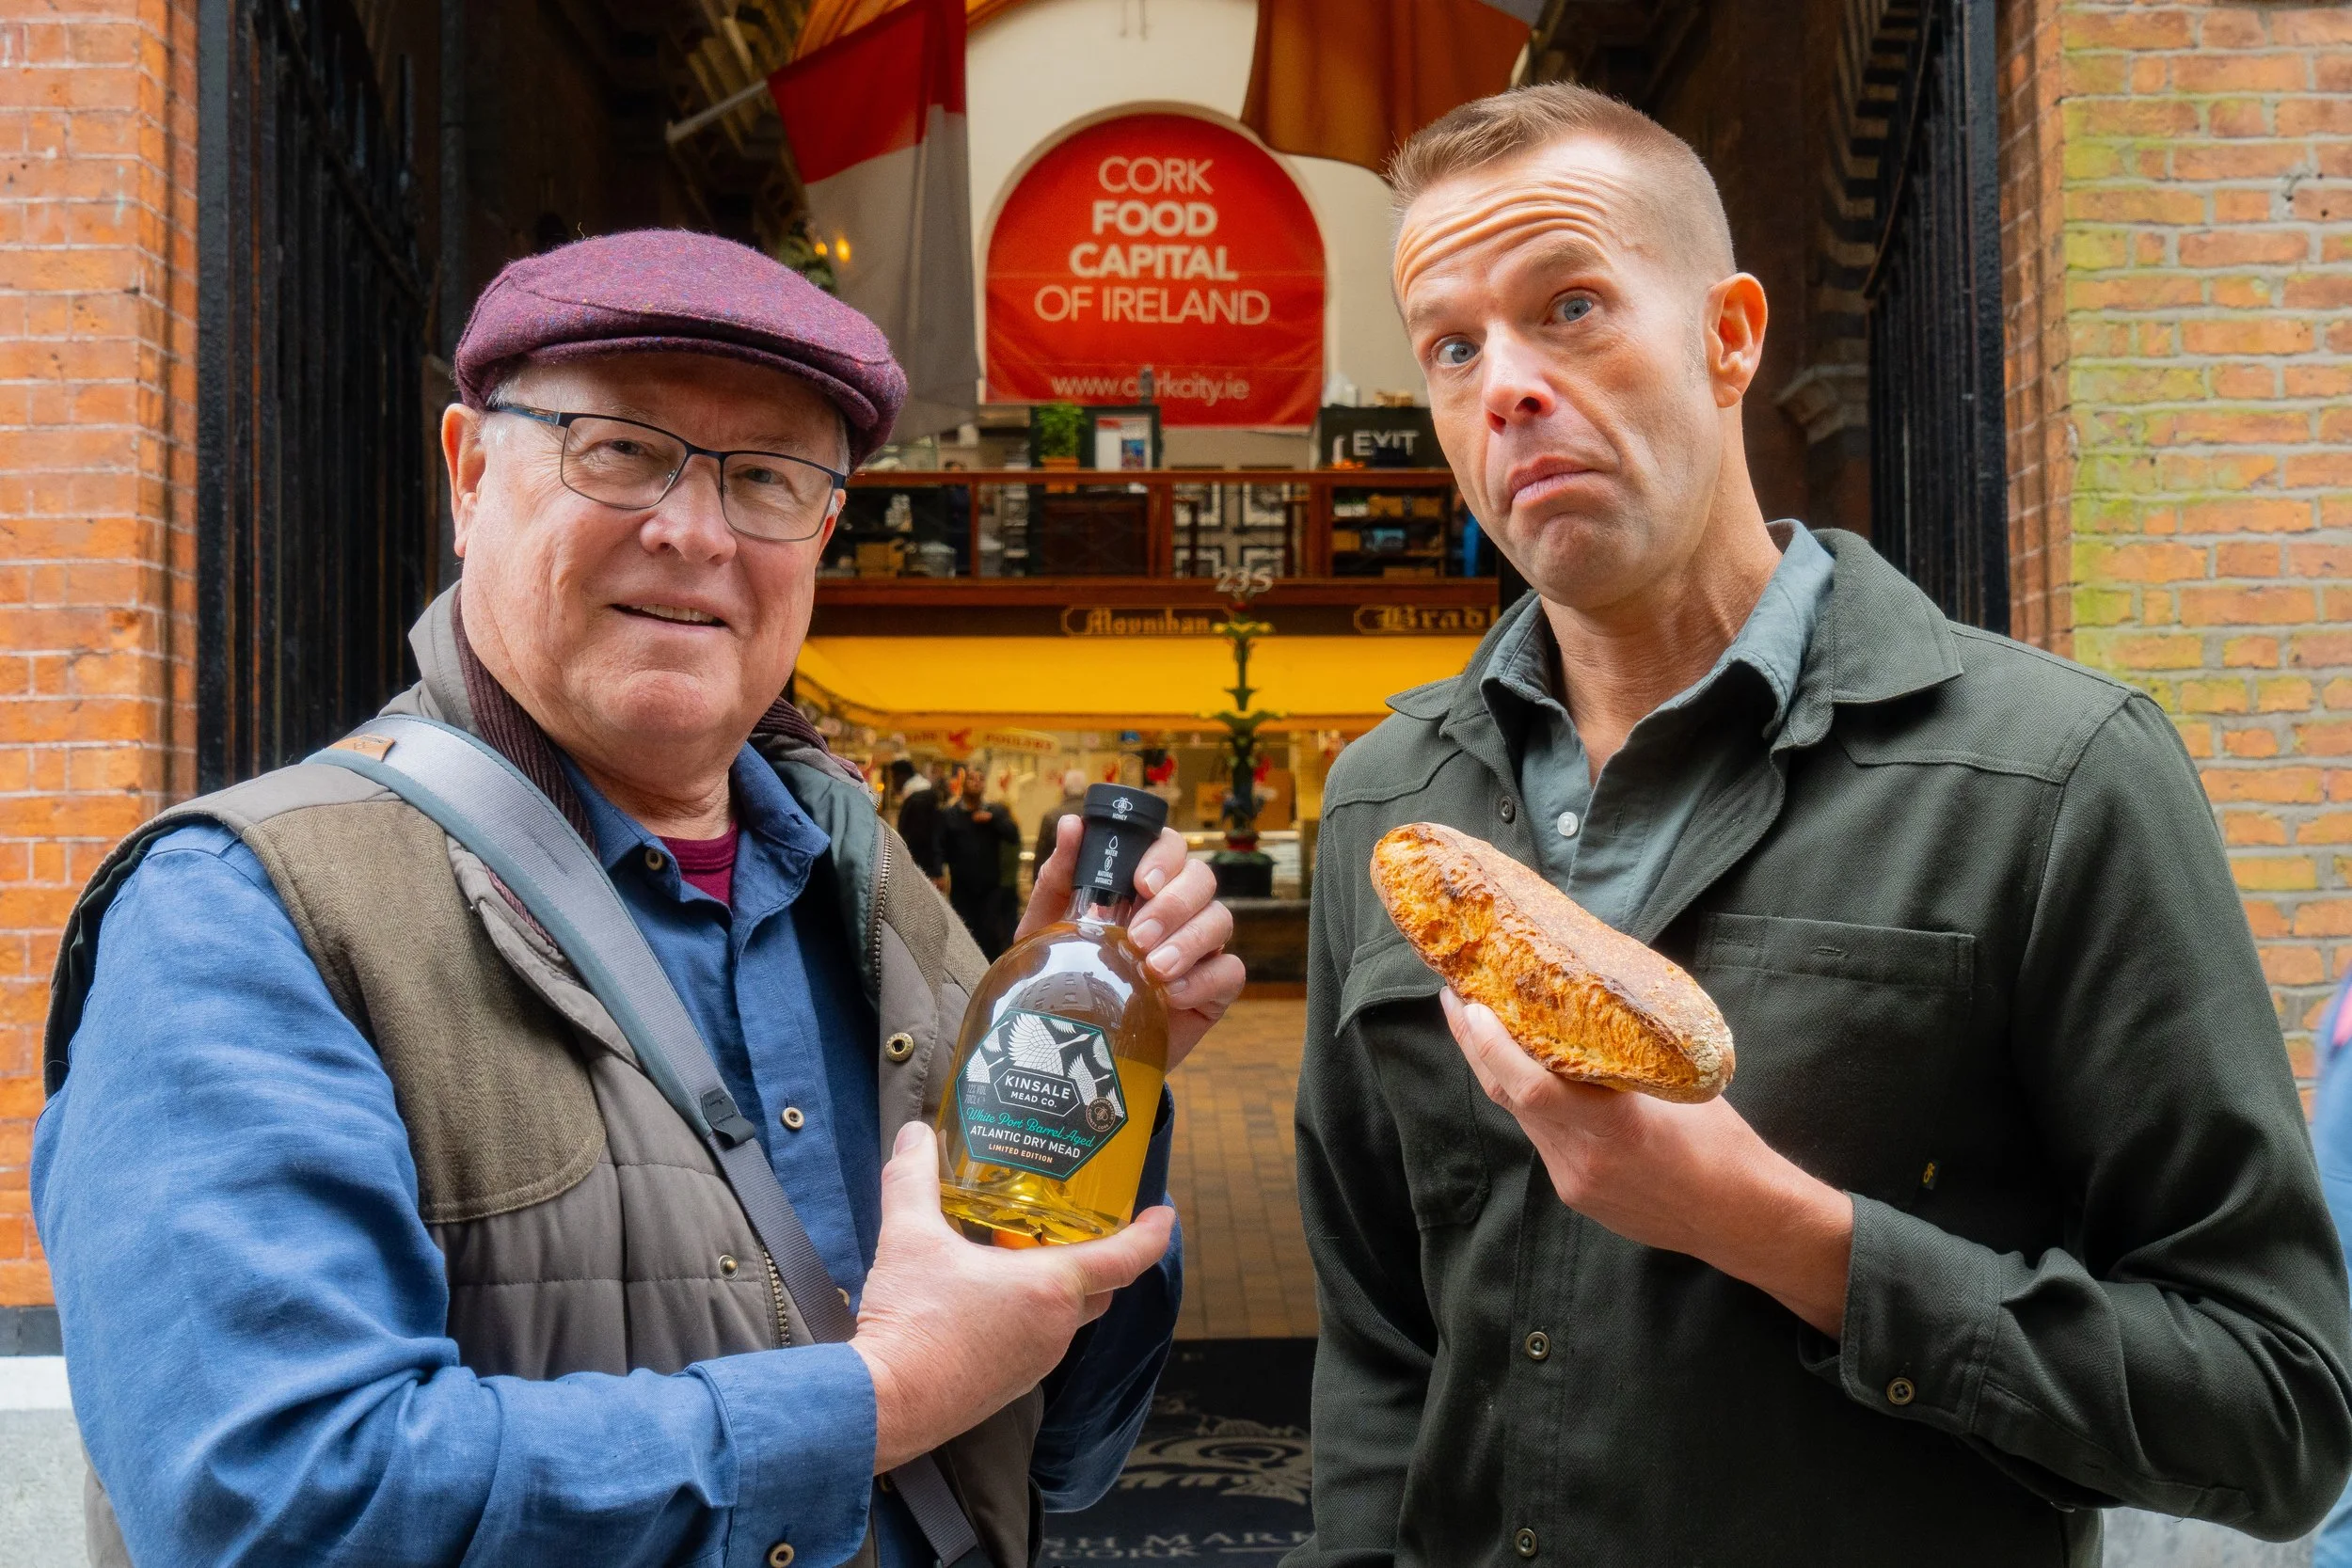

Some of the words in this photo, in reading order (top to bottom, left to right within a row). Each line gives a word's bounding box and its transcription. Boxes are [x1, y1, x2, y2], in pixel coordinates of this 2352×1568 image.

[1098, 156, 1214, 195] CORK
[1091, 200, 1218, 236] FOOD
[1068, 242, 1239, 282] CAPITAL
[1034, 285, 1094, 323] OF
[1102, 286, 1270, 325] IRELAND
[1051, 372, 1249, 406] www.crkcity.ie
[1005, 1075, 1071, 1100] KINSALE
[1010, 1091, 1038, 1102] MEAD
[1041, 1098, 1057, 1108] CO.
[966, 1107, 995, 1123] White
[998, 1112, 1023, 1129] Port
[1025, 1117, 1064, 1138] Barrel
[1062, 1130, 1095, 1148] Aged
[970, 1125, 1021, 1143] ATLANTIC
[1024, 1134, 1046, 1148] DRY
[1048, 1141, 1081, 1158] MEAD
[988, 1143, 1019, 1155] LIMITED
[1021, 1149, 1053, 1164] EDITION
